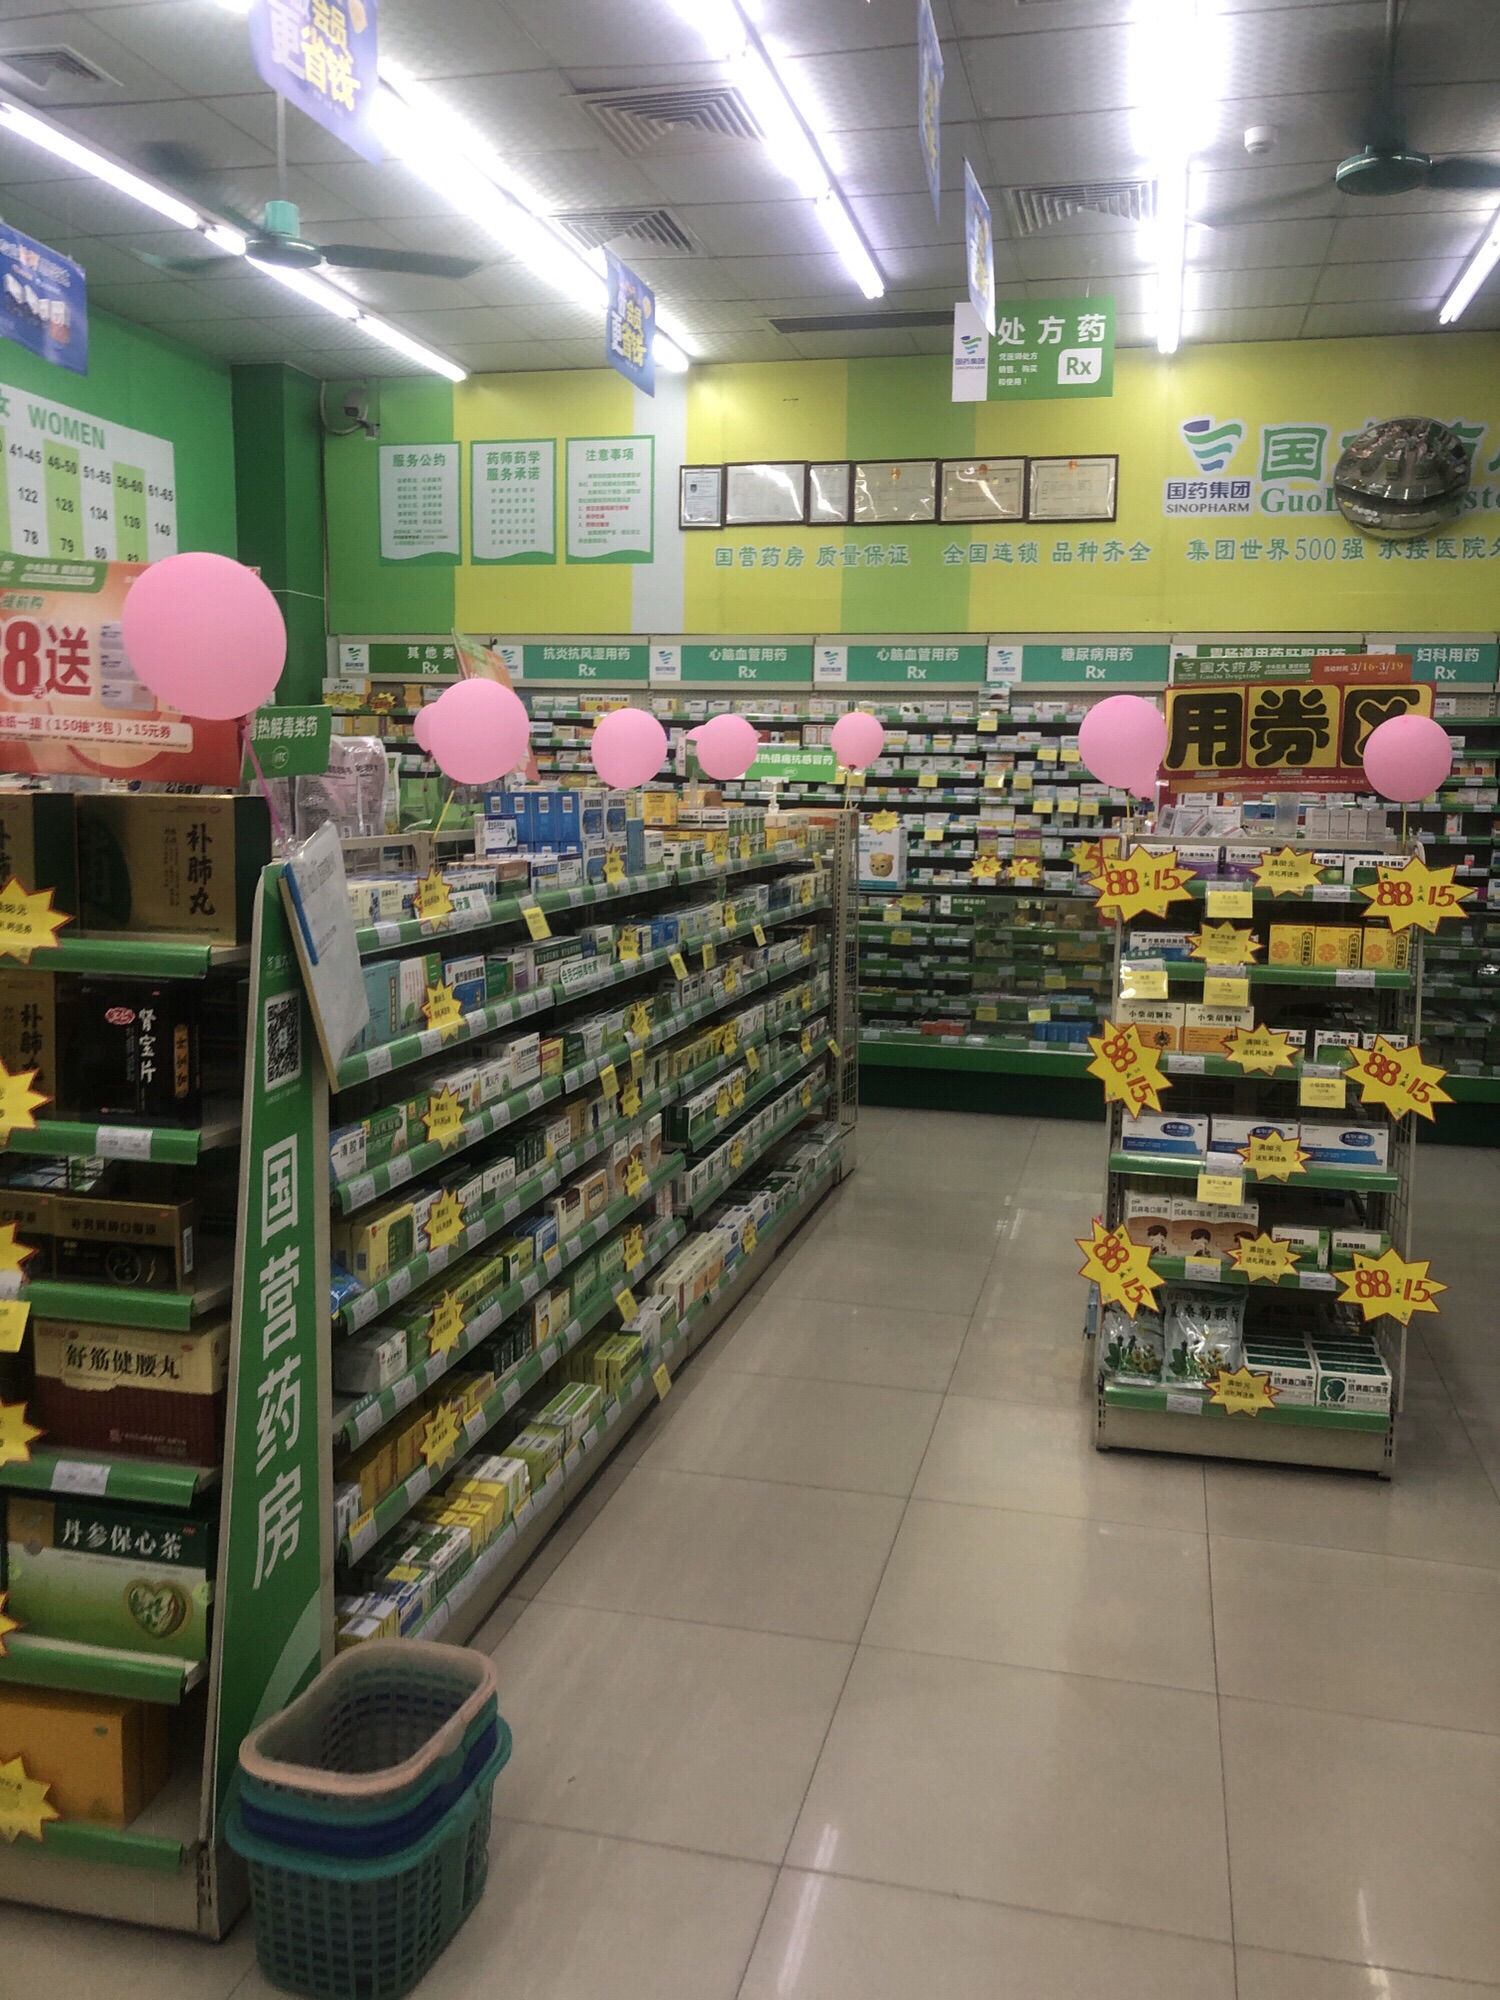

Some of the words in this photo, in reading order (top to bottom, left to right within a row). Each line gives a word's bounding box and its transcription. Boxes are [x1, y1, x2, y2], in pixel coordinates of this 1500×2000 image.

[998, 314, 1107, 346] 处方药
[1066, 357, 1092, 376] Rx
[27, 404, 106, 450] WOMEN
[392, 453, 446, 467] 服务公约
[486, 450, 541, 466] 药师药学
[585, 448, 635, 462] 注意事项
[486, 466, 541, 482] 服务承诺
[18, 487, 39, 504] 122
[1167, 481, 1250, 499] 国药集团
[1166, 503, 1249, 513] SINOPHARM
[59, 538, 75, 553] 79
[714, 545, 805, 567] 国营药房
[816, 544, 910, 566] 质量保证
[942, 542, 1039, 564] 全国连锁
[1052, 541, 1152, 563] 品种齐全
[1186, 538, 1365, 561] 集团世界500强
[543, 647, 631, 661] 抗炎抗风湿用药
[709, 648, 788, 661] 心脑血管用药
[877, 648, 960, 662] 心脑血管用药
[1061, 648, 1133, 662] 糖尿病用药
[1416, 647, 1480, 663] 妇科用药
[422, 662, 440, 674] Rx
[578, 664, 597, 677] Rx
[738, 665, 757, 679] Rx
[907, 666, 927, 679] Rx
[1085, 665, 1106, 679] Rx
[1200, 661, 1262, 674] 国大药房
[1434, 666, 1457, 680] Rx
[187, 822, 216, 917] 补肺丸
[1018, 867, 1028, 877] 6
[1105, 868, 1140, 896] 88
[1153, 868, 1182, 891] 15
[1376, 881, 1413, 907] 88
[1428, 885, 1456, 907] 15
[1128, 1010, 1173, 1019] 小柴胡颗粒
[1197, 1014, 1242, 1023] 小柴胡颗粒
[1101, 1032, 1138, 1073] 88
[1363, 1051, 1402, 1087] 88
[1126, 1075, 1156, 1103] 15
[1406, 1077, 1437, 1104] 15
[1092, 1233, 1130, 1274] 88
[1121, 1276, 1151, 1303] 15
[1355, 1269, 1392, 1298] 88
[1403, 1278, 1432, 1303] 15
[65, 1343, 180, 1381] 舒筋健腰丸
[252, 1132, 303, 1590] 国营药房
[61, 1518, 183, 1560] 丹参保心茶
